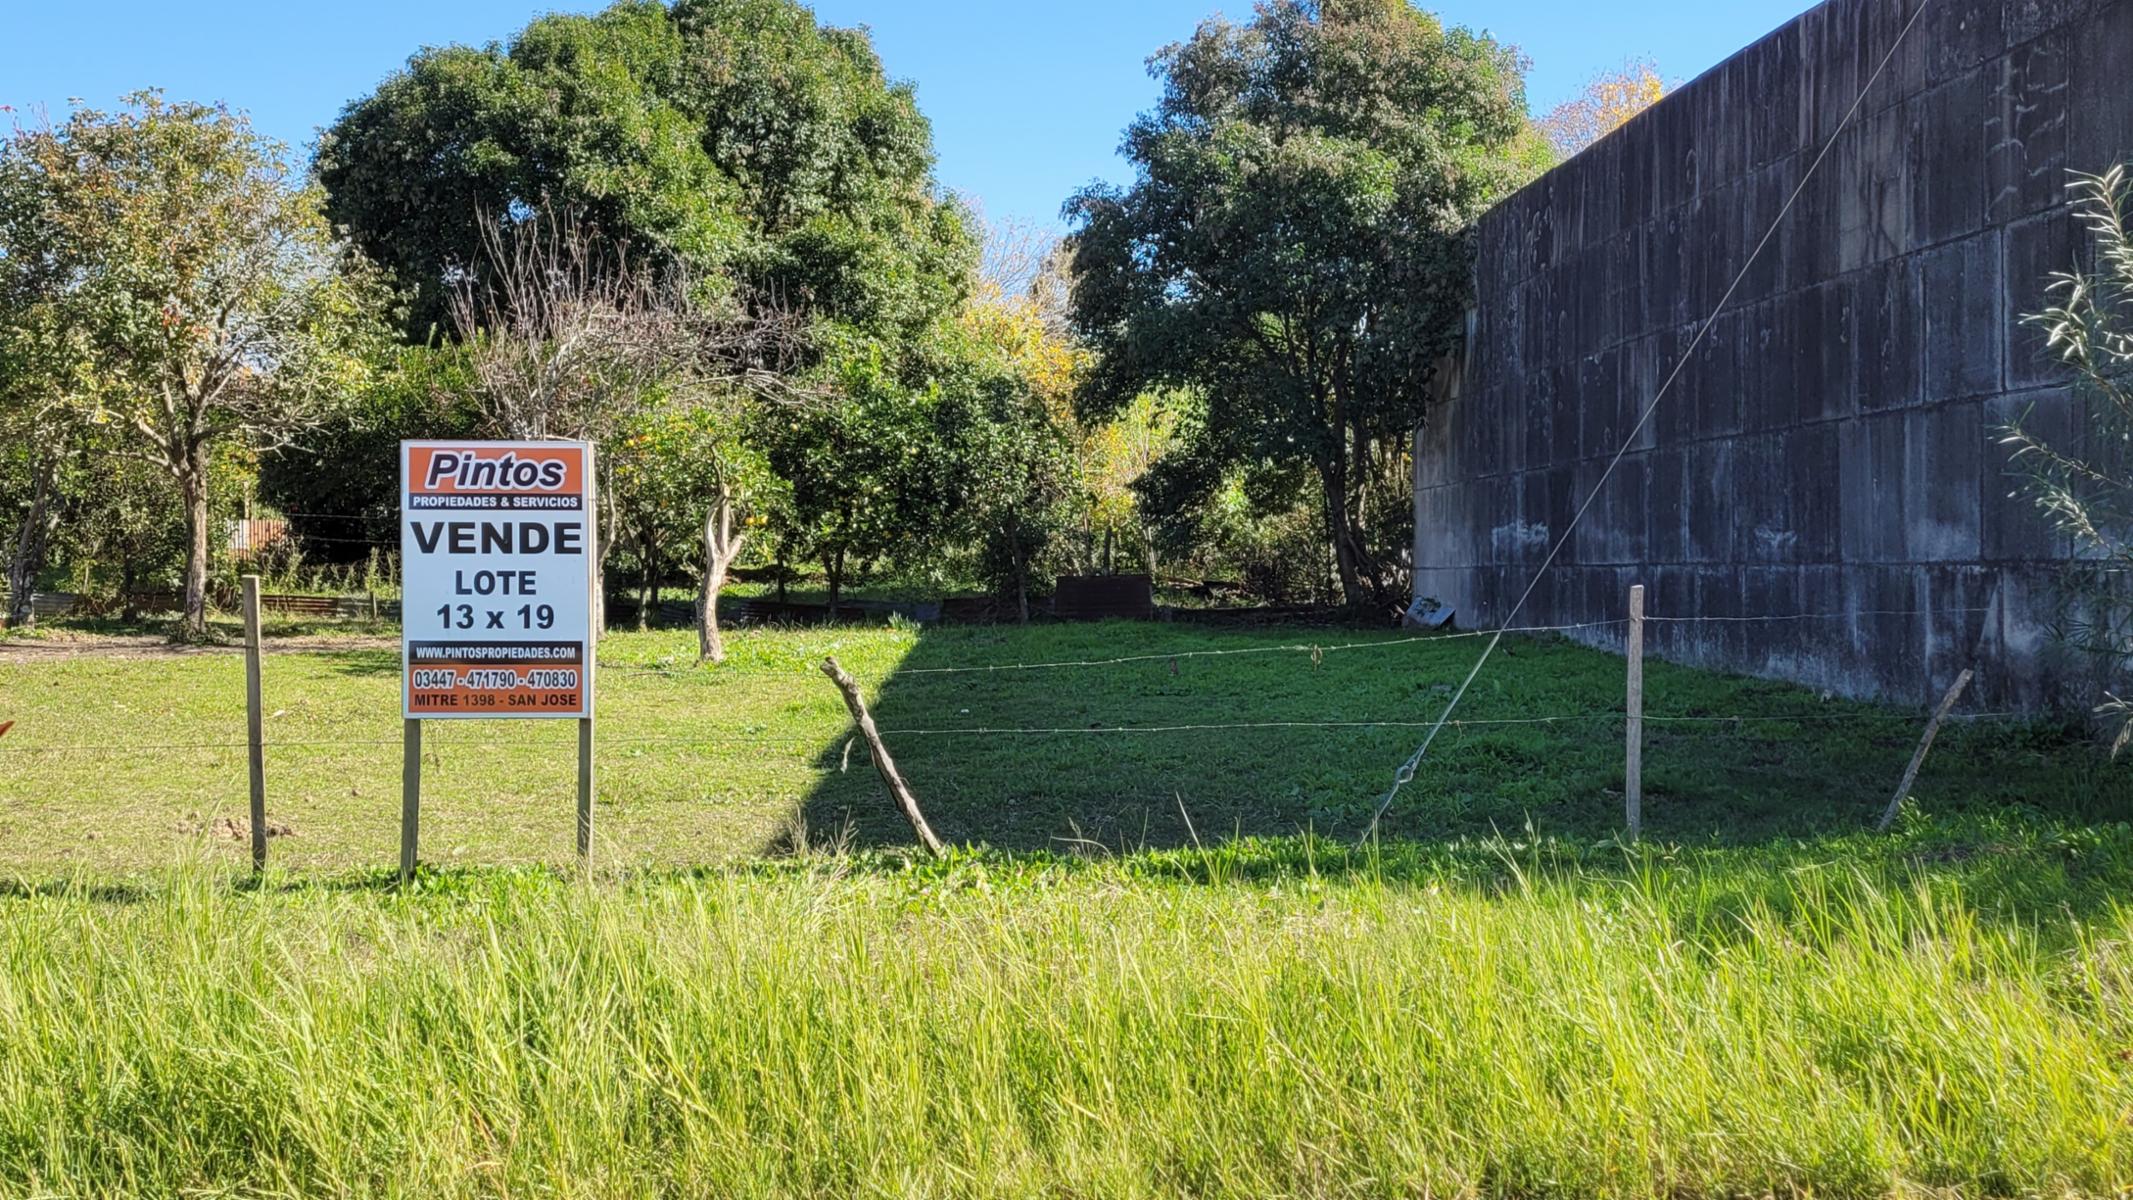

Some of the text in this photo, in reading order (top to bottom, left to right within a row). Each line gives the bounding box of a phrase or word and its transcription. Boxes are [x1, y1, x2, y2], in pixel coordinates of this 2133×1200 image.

[427, 453, 564, 488] Pintos
[412, 496, 578, 508] PROPIEDADES & SERVICIOS
[410, 521, 582, 555] VENDE
[455, 570, 537, 596] LOTE
[436, 603, 555, 630] 13 x 19
[416, 647, 576, 660] WWW.PINTOSPROPIEDADES.COM
[414, 694, 458, 706] MITRE
[463, 694, 496, 706] 1398
[507, 694, 537, 706] SAN
[541, 694, 577, 706] JOSE
